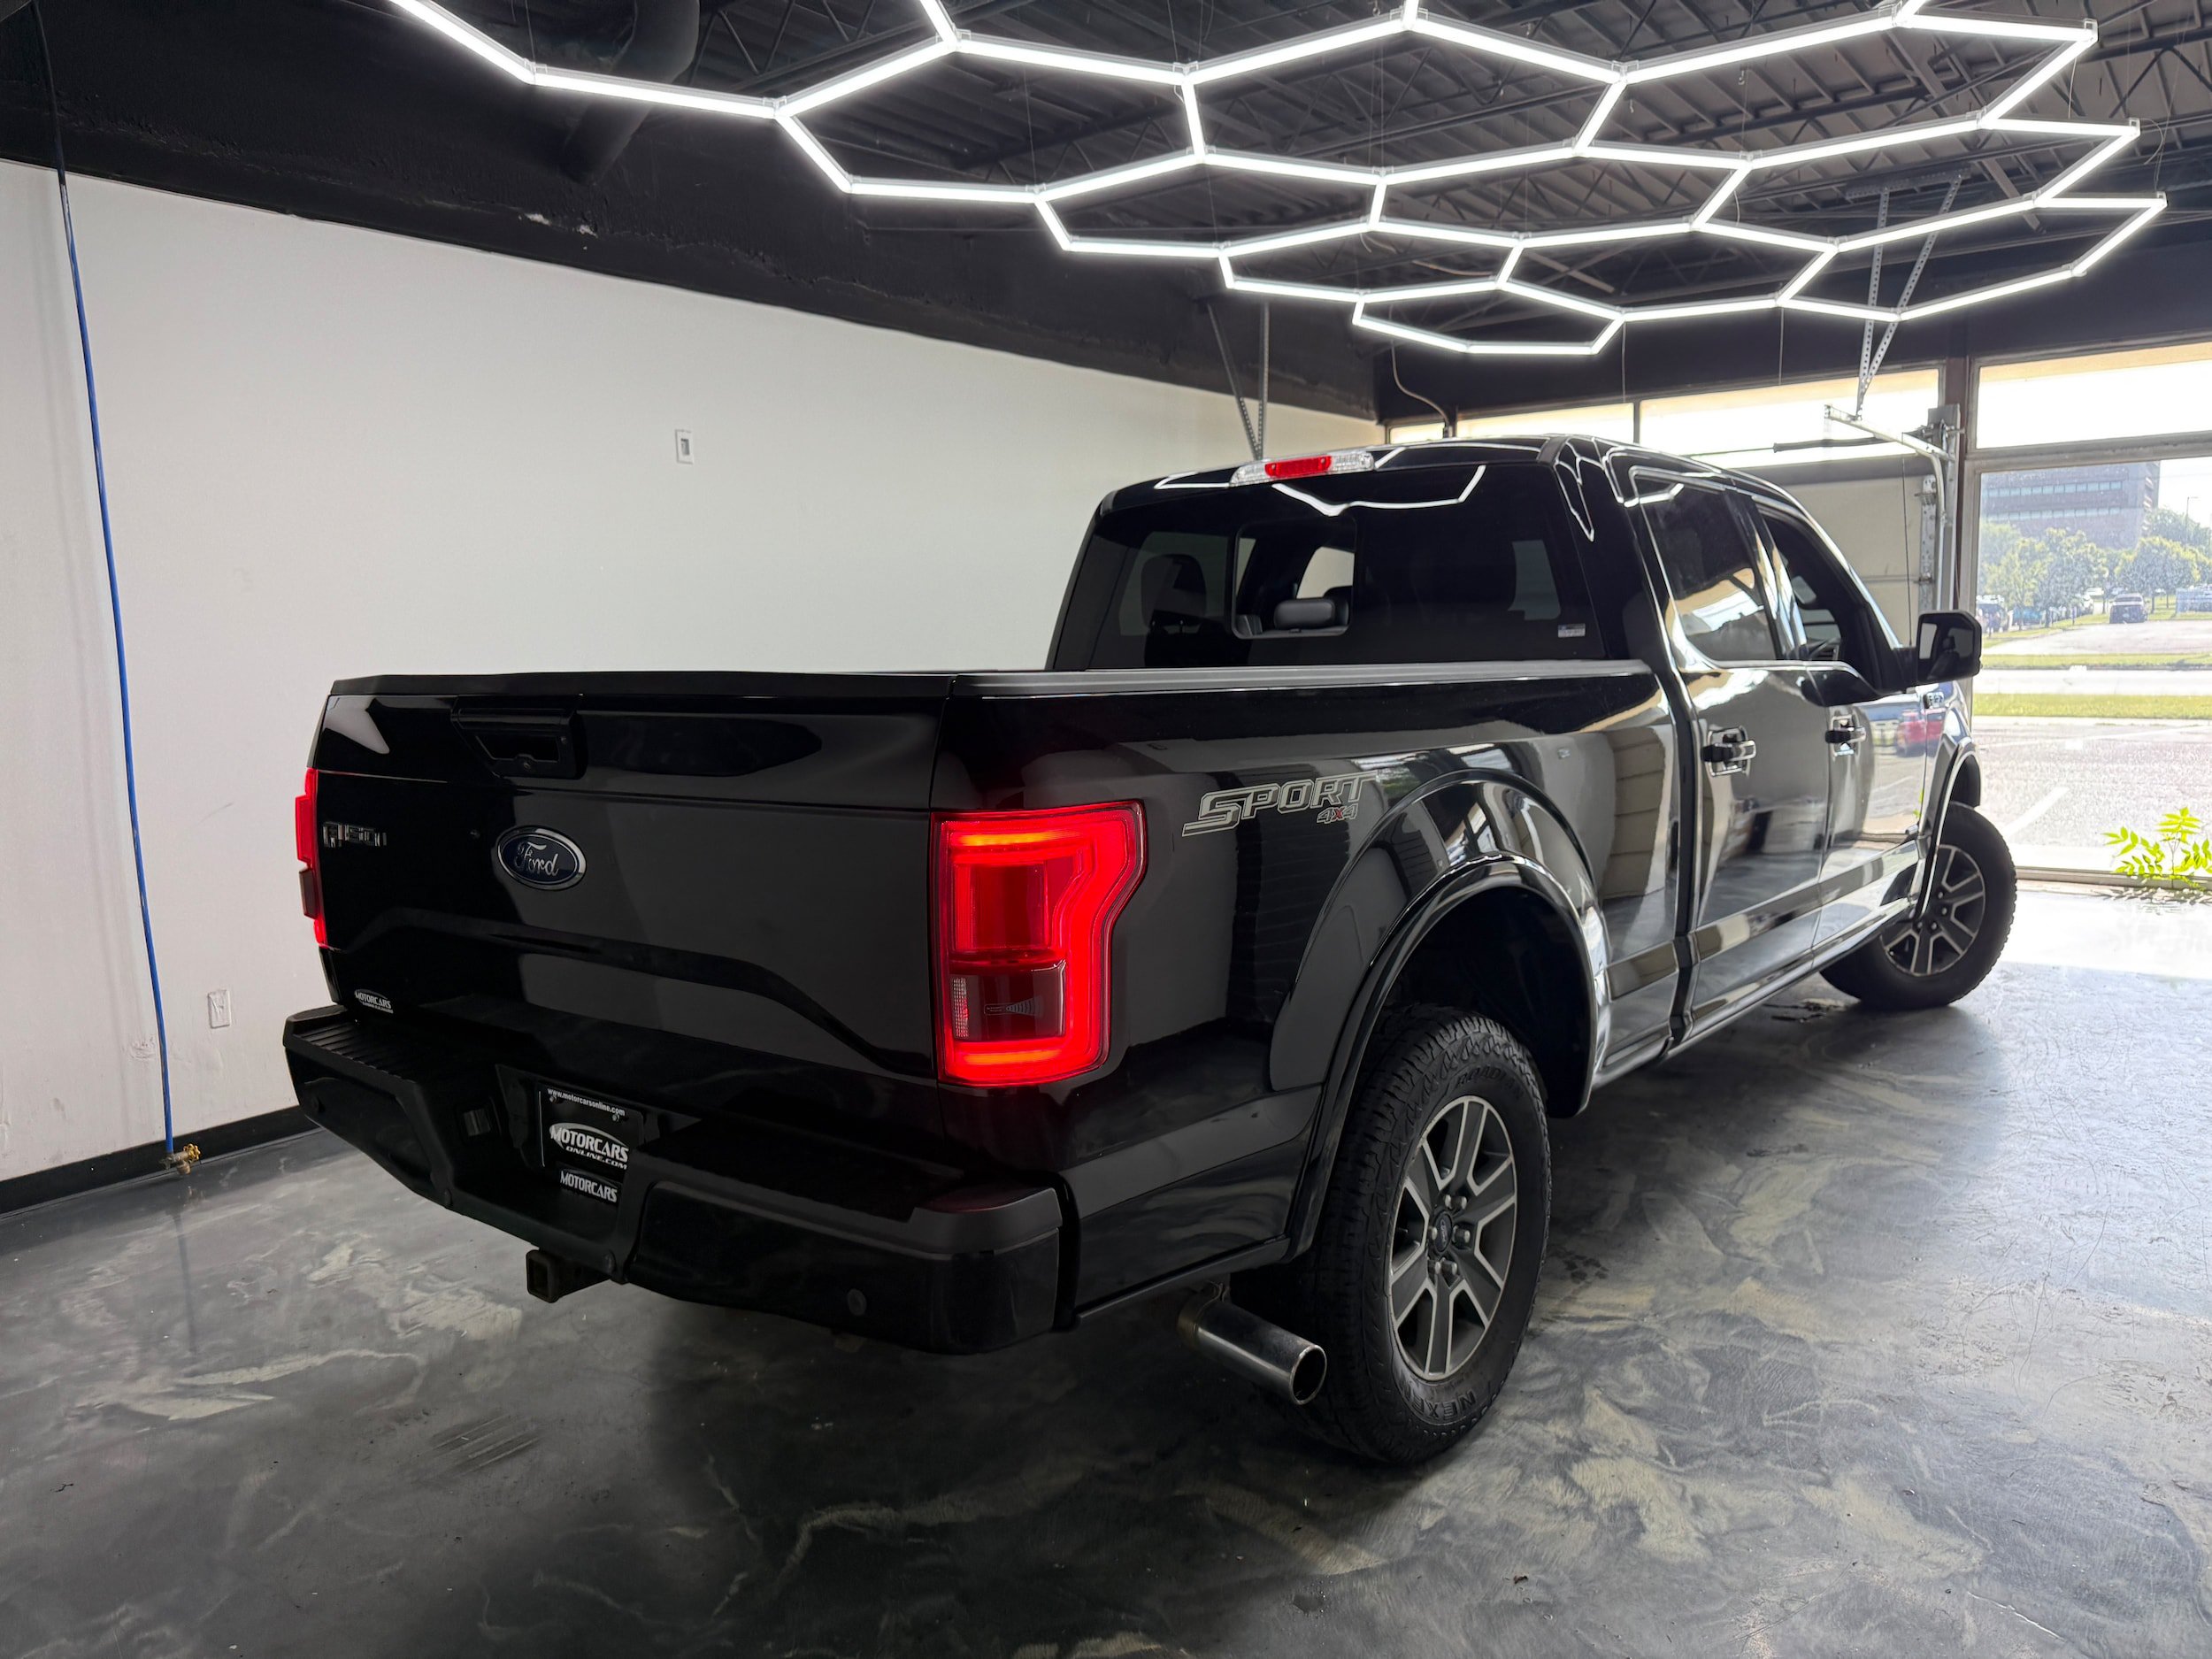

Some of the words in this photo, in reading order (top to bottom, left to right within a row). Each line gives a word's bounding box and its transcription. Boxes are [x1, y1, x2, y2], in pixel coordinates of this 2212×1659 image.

[1181, 770, 1379, 837] SPORT
[514, 841, 559, 877] Ford
[355, 991, 392, 1009] MOTORCARS
[547, 1087, 626, 1116] www.motorcarsonline.com
[550, 1126, 629, 1163] MOTORCARS
[565, 1146, 627, 1170] ONLINE.COM
[560, 1170, 618, 1203] MOTORCARS
